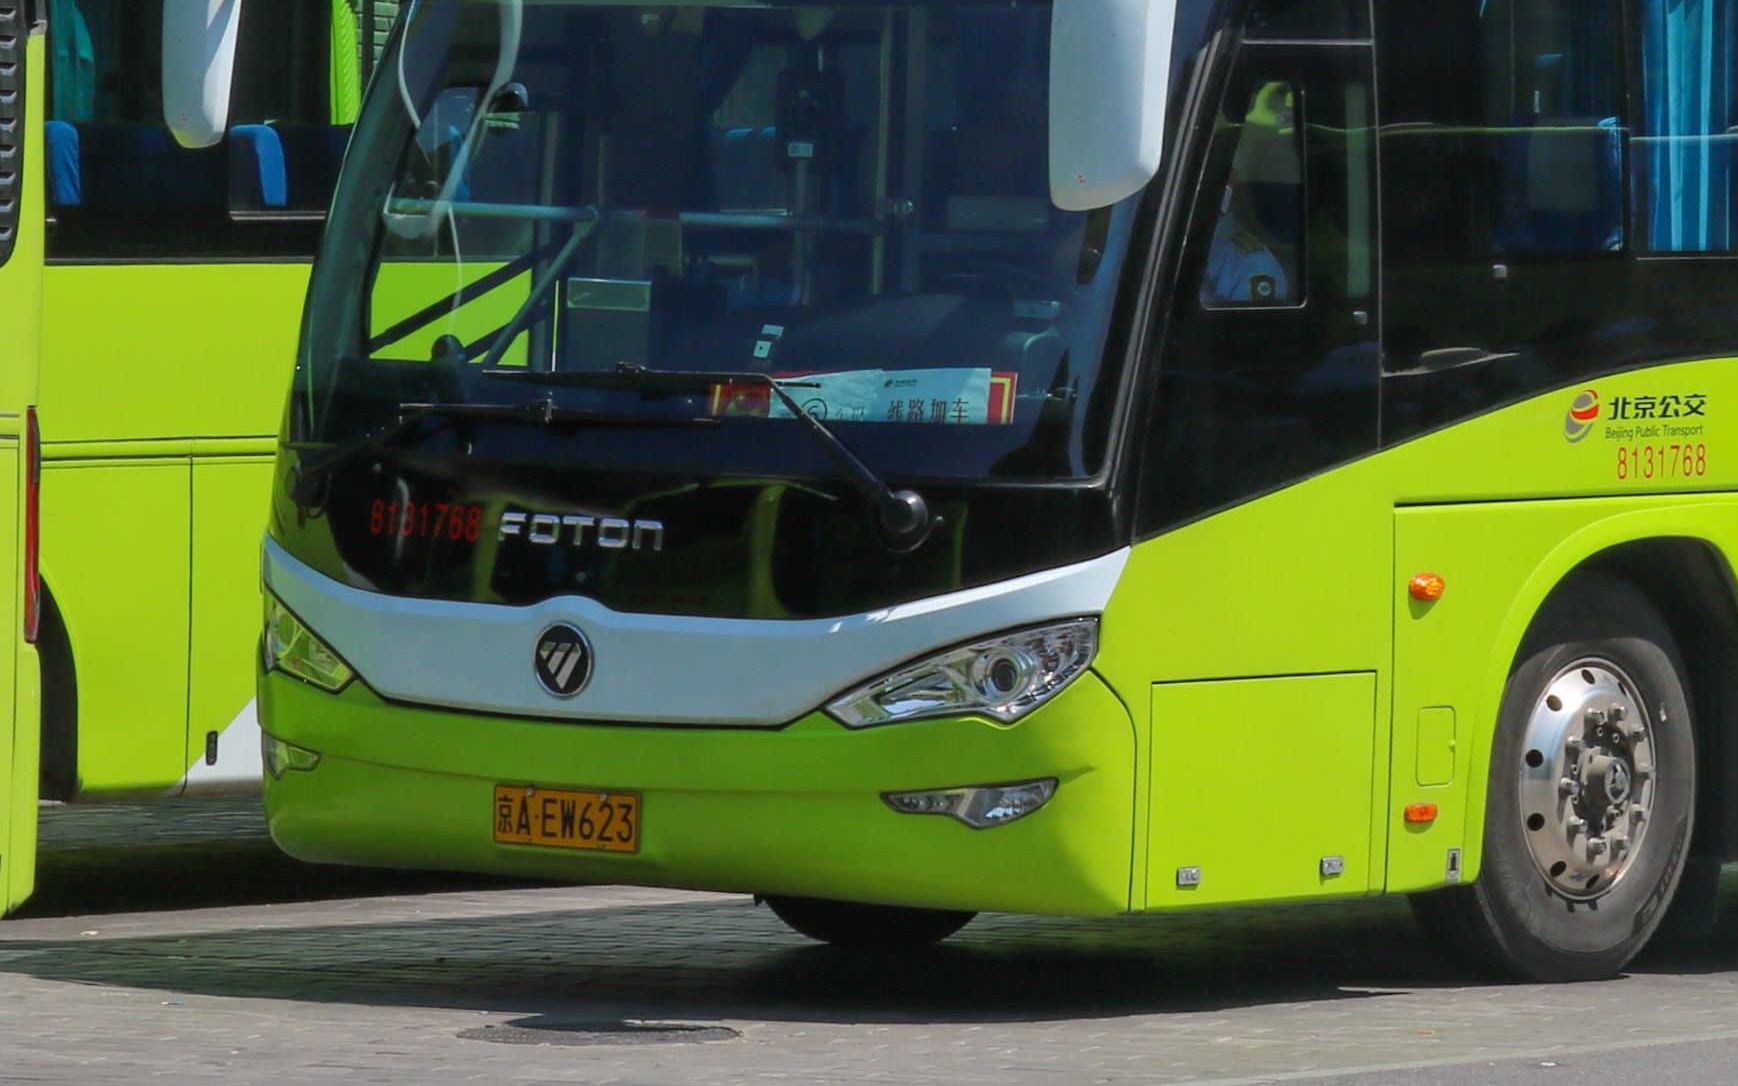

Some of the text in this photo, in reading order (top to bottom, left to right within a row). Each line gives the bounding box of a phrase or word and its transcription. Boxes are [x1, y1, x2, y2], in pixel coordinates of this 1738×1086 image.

[887, 398, 970, 424] 线路加车
[1607, 394, 1707, 421] 北京公交
[1605, 424, 1703, 441] Beijing Public Transport
[1617, 443, 1706, 480] 8131768
[369, 500, 482, 542] 8131768
